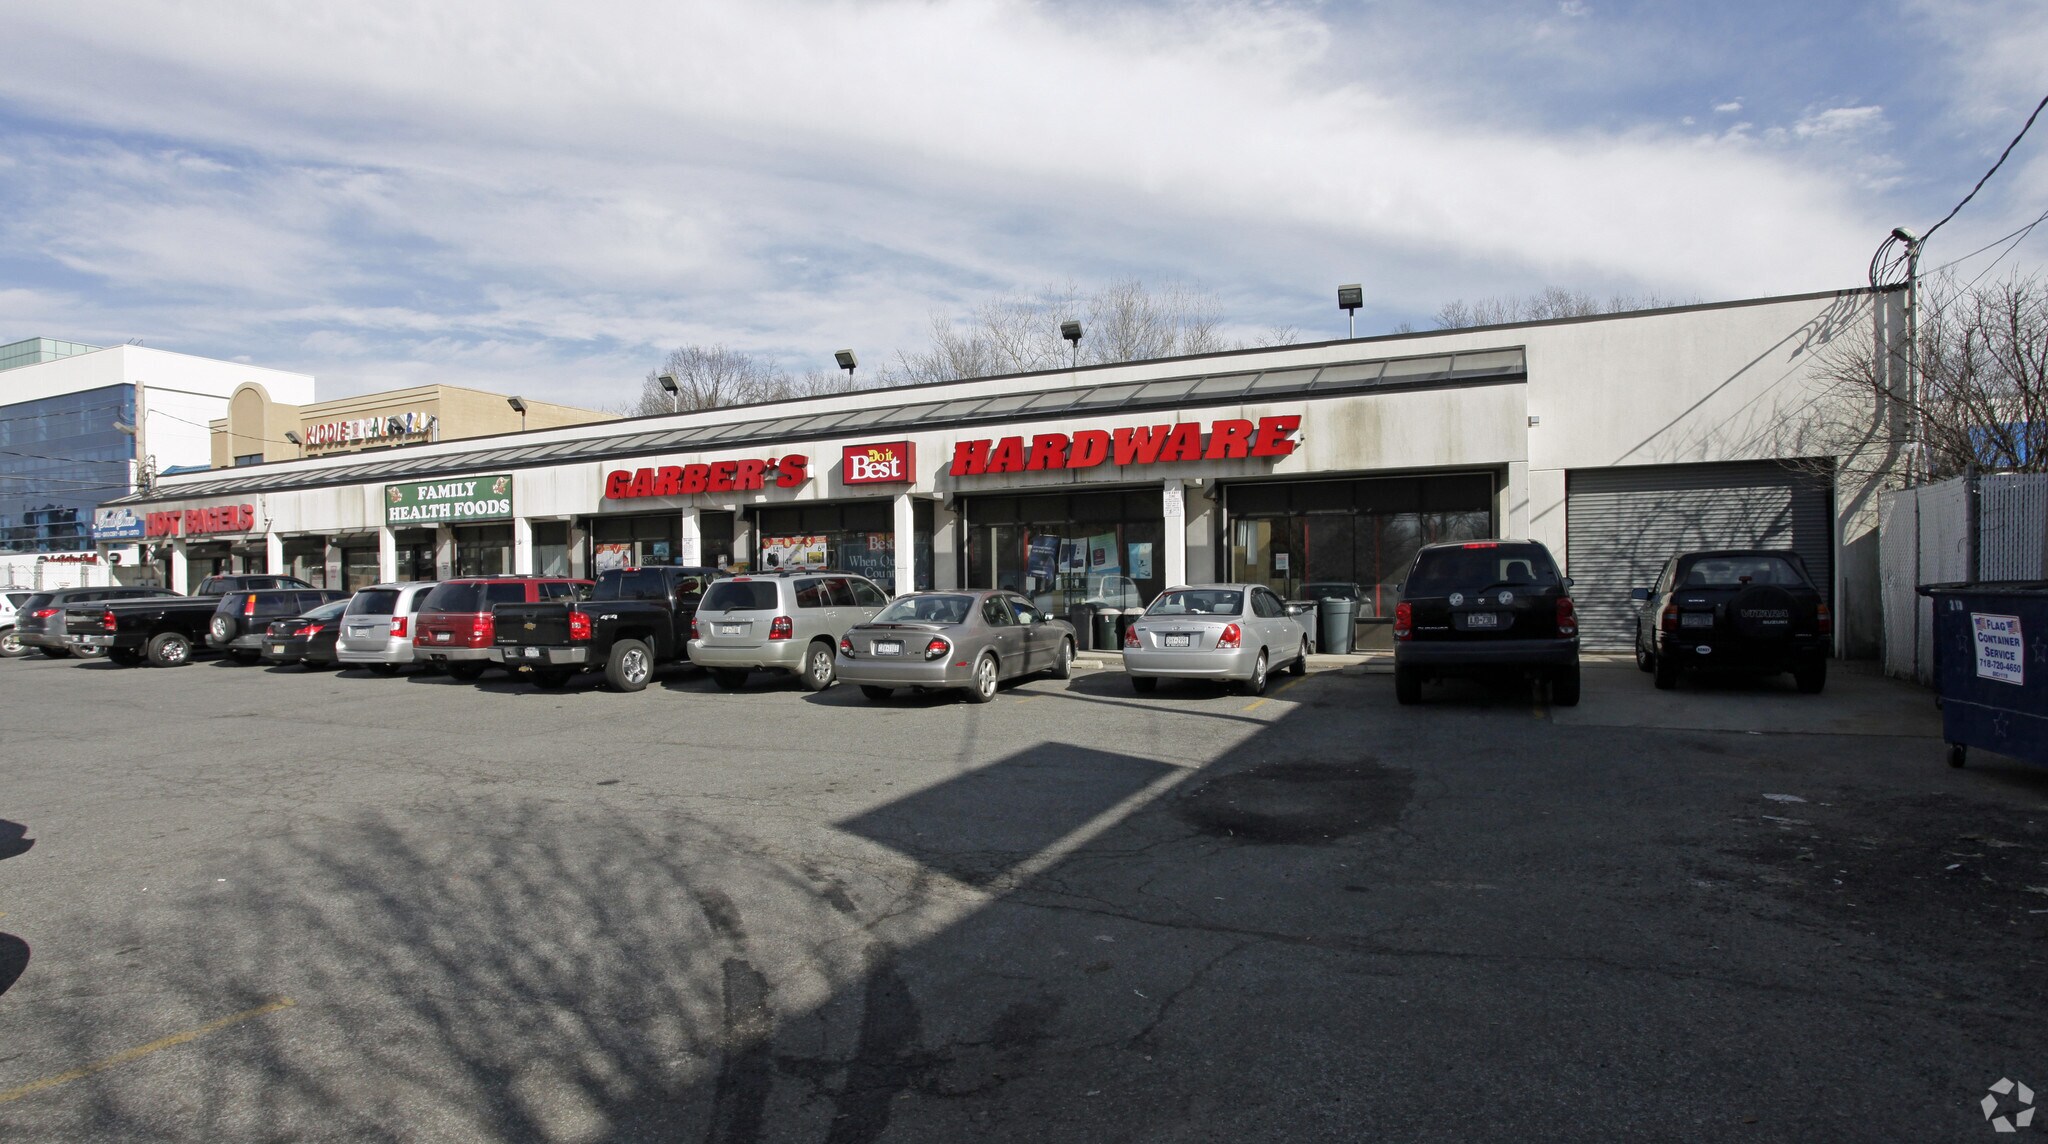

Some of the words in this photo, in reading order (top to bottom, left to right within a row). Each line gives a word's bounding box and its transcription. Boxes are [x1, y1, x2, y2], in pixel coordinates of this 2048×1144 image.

[306, 421, 349, 444] KIDDIE
[949, 415, 1302, 476] HARDWARE
[868, 449, 884, 462] Do
[885, 449, 893, 461] it
[605, 453, 810, 499] GARBER'S
[850, 455, 900, 480] Best
[417, 481, 477, 500] FAMILY
[389, 503, 451, 521] HEALTH
[454, 499, 510, 517] FOODS
[145, 511, 182, 537] HOT
[185, 504, 254, 534] BAGELS
[849, 555, 877, 567] When
[1741, 609, 1789, 618] VITARA
[1986, 619, 2006, 631] FLAG
[1978, 632, 2020, 647] CONTAINER
[1985, 646, 2015, 661] SERVICE
[1979, 658, 2021, 674] 718-720-4650
